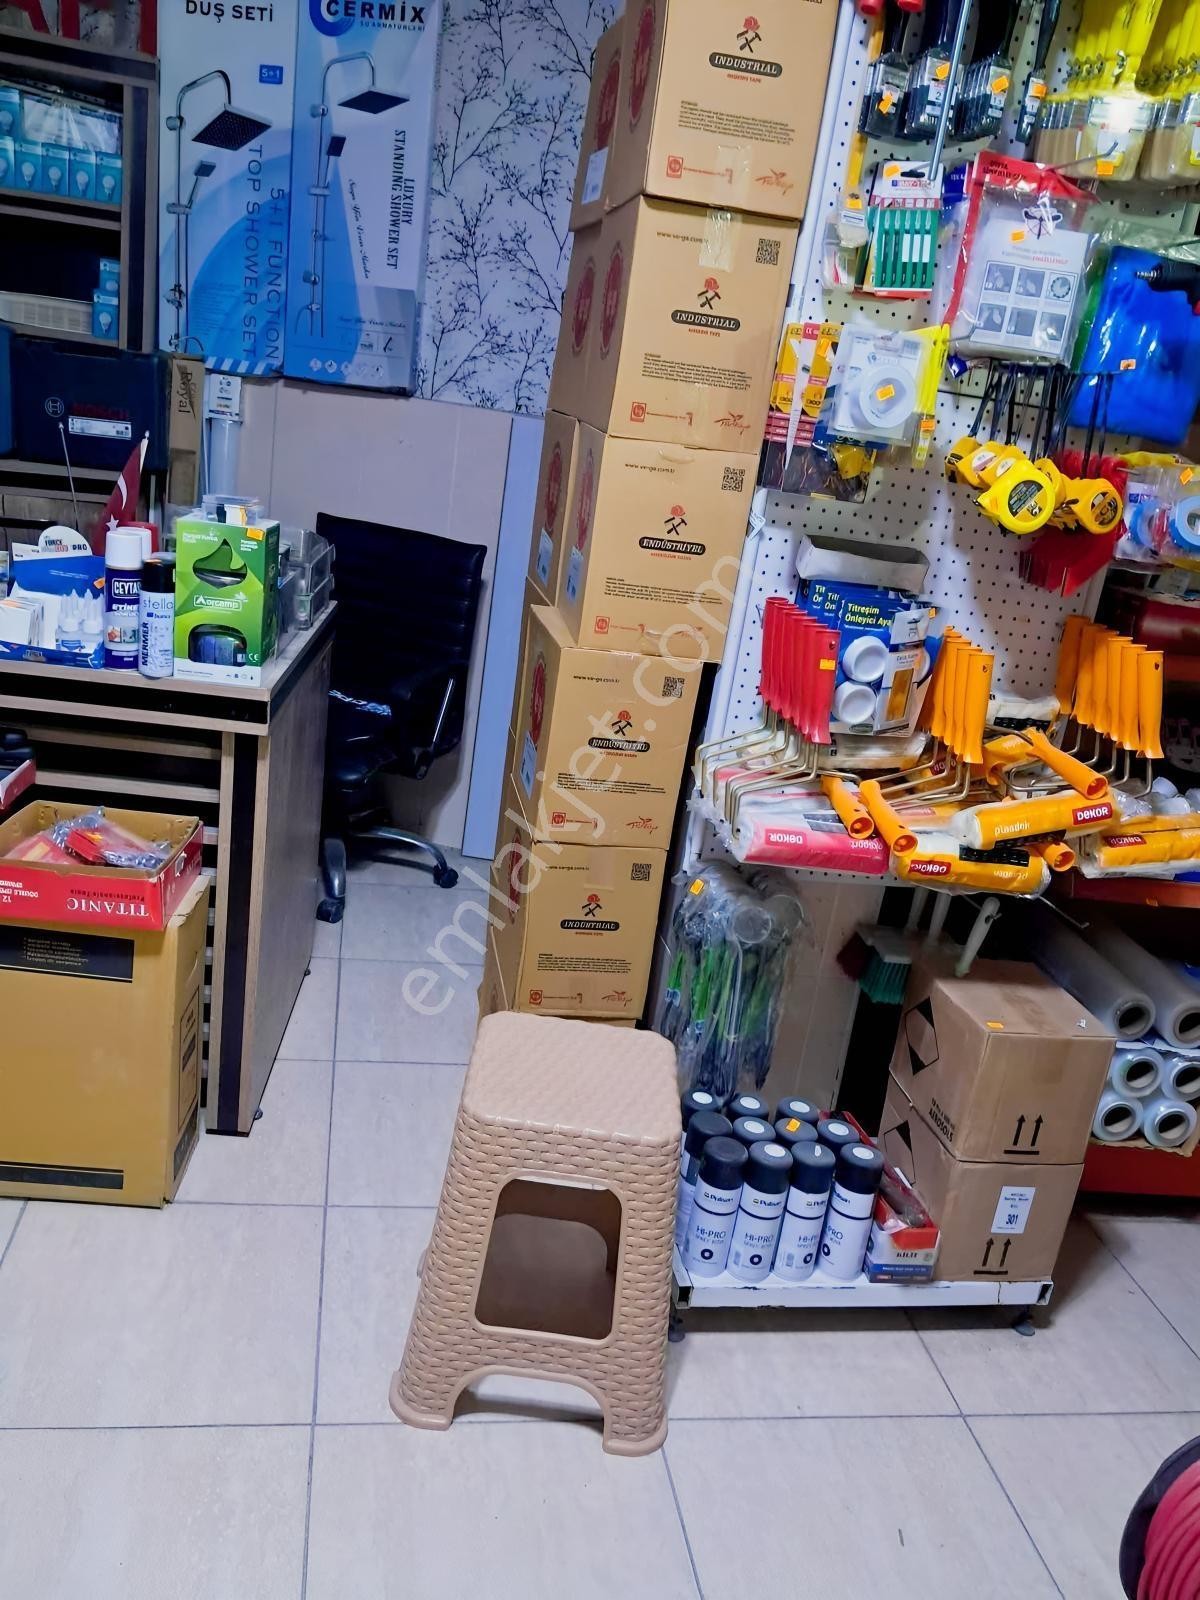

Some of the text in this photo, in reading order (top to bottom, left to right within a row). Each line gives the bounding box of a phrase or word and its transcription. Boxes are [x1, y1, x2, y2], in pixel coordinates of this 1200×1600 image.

[185, 0, 273, 23] DUŞ SETİ
[326, 0, 425, 24] CERMİX
[714, 55, 778, 74] INDUSTRIAL
[387, 130, 406, 270] STANDING SHOWER SET
[401, 178, 415, 226] LUXURY
[242, 144, 262, 358] TOP SHOWER SET
[266, 240, 283, 360] FUNCTION
[675, 312, 737, 329] INDUSTRIAL
[642, 538, 703, 554] ENDÜSTRİYEL
[143, 596, 174, 609] stella
[847, 603, 880, 616] Titreşim
[844, 613, 877, 627] Önleyici
[141, 622, 149, 666] MERMER
[66, 897, 149, 917] TITANIC
